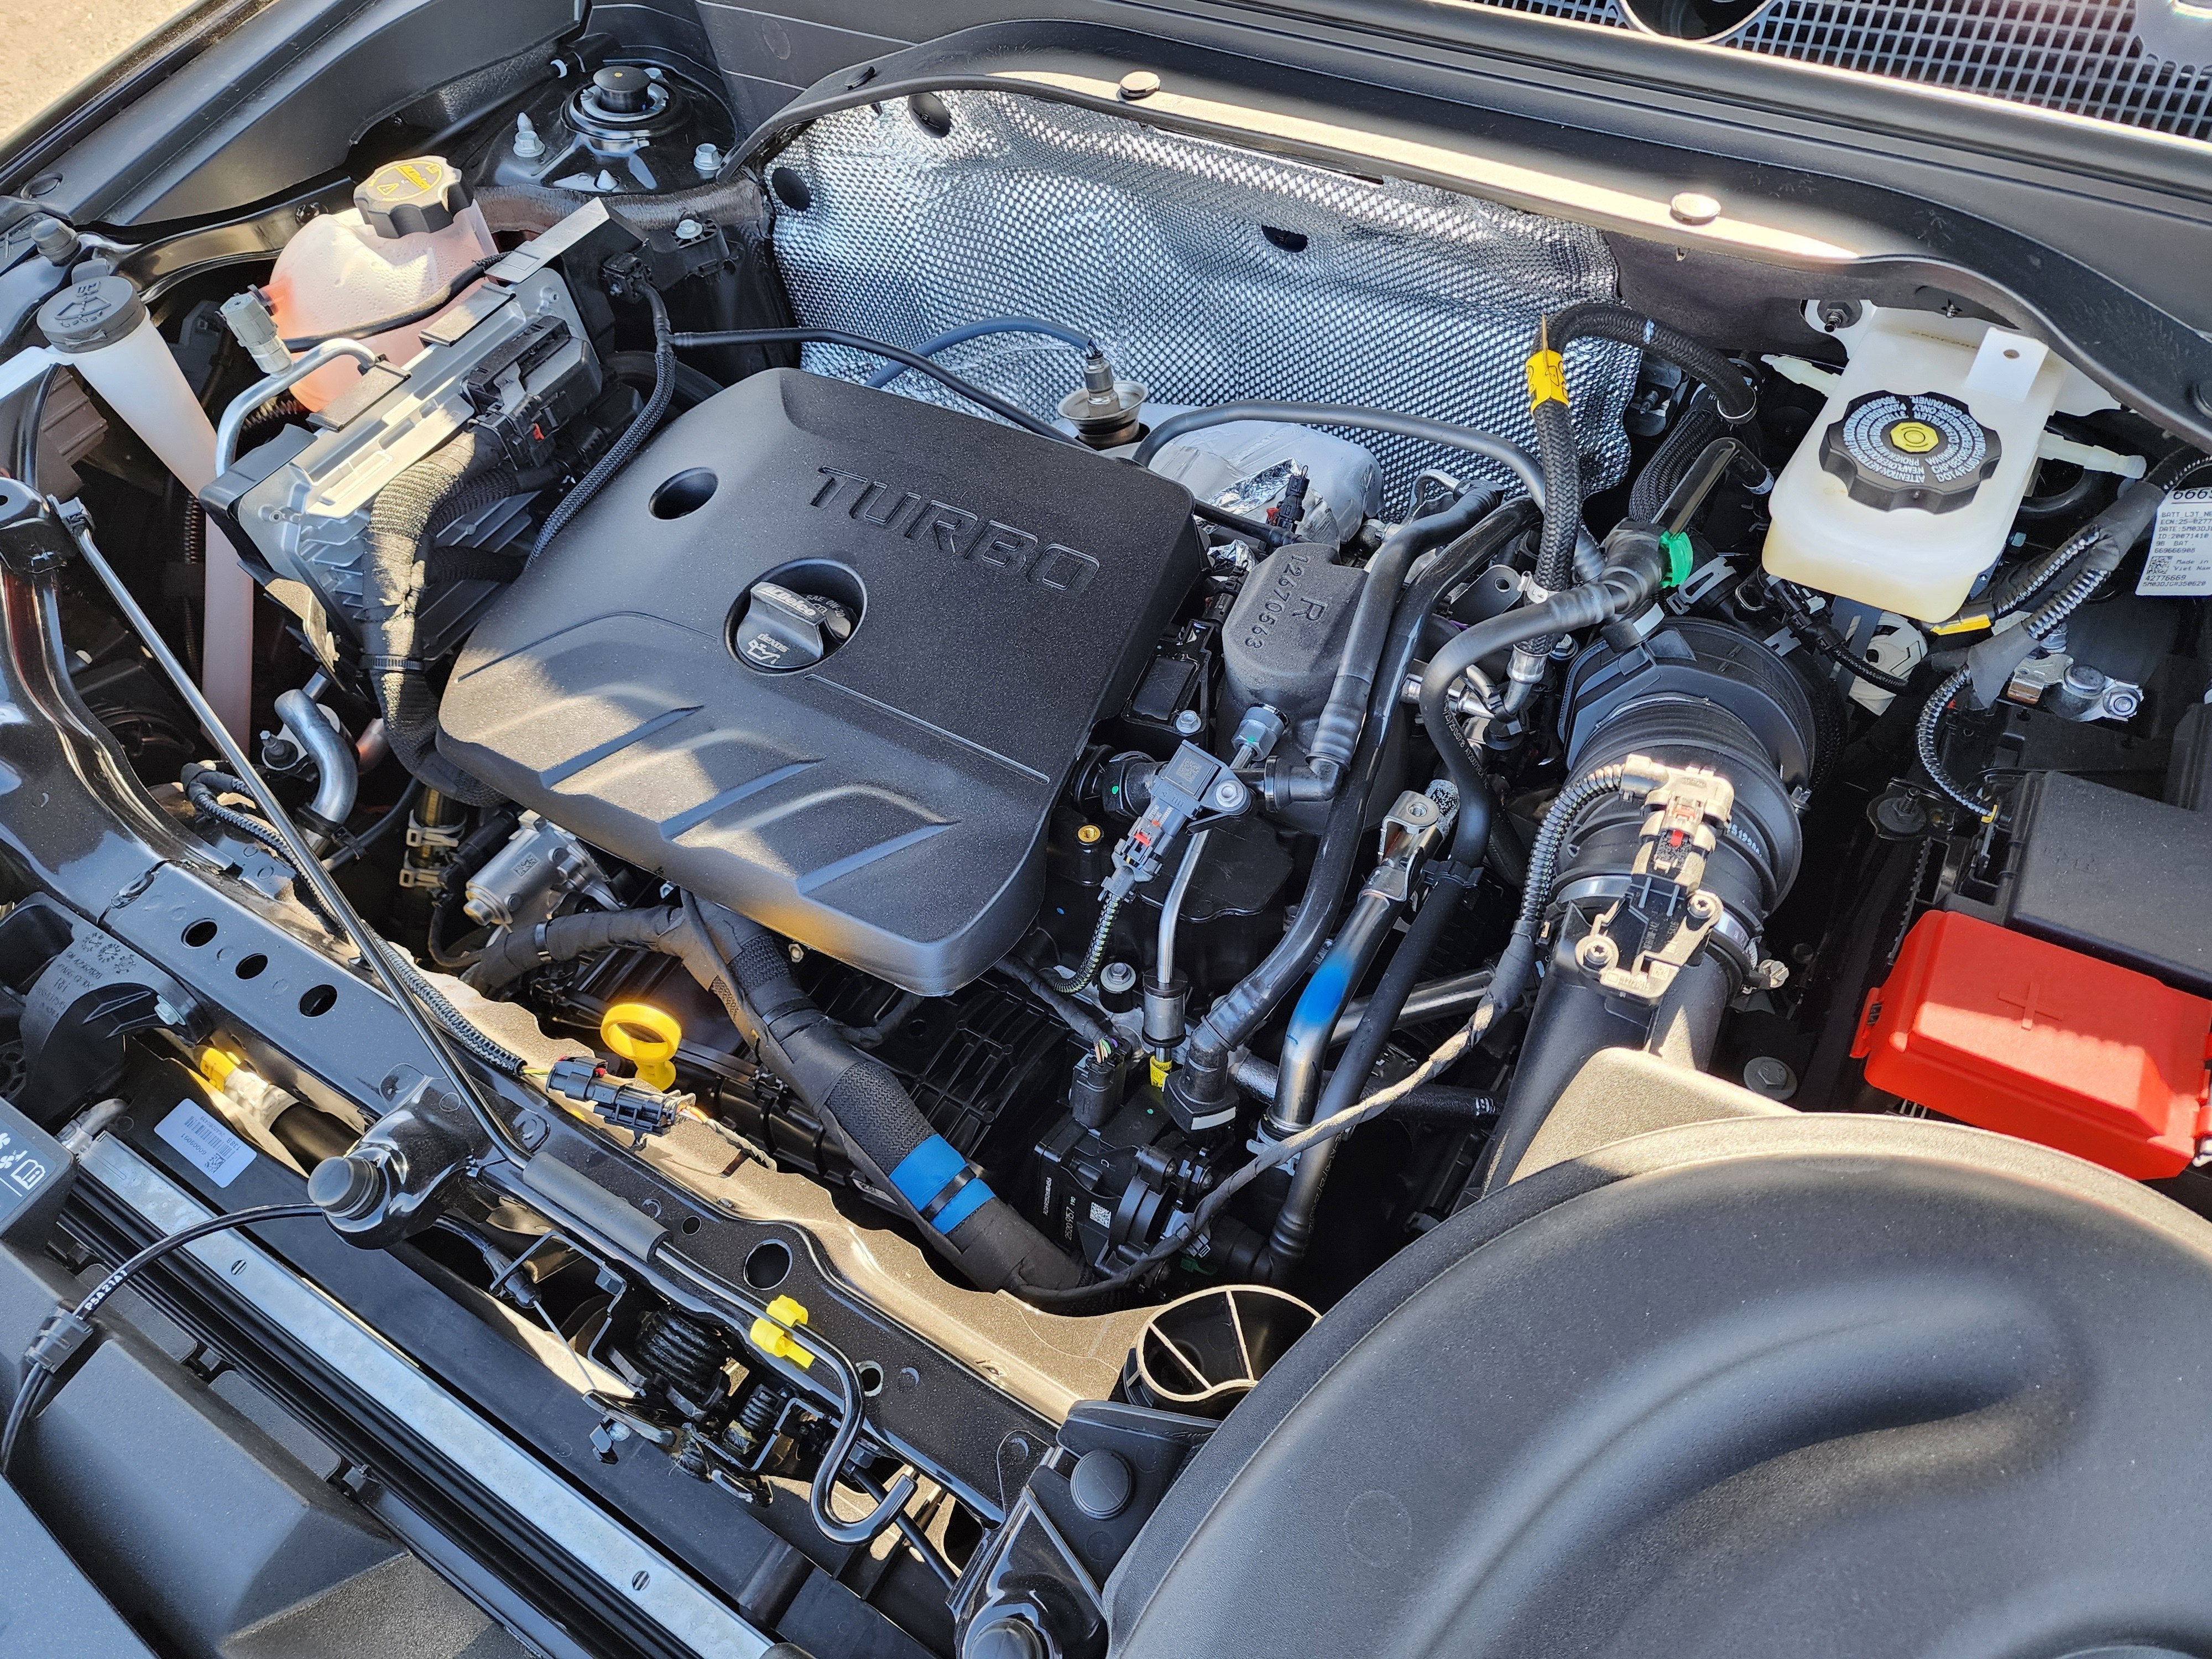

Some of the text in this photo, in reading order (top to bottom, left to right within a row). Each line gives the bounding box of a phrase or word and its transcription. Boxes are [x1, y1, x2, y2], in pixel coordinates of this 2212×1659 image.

[2173, 488, 2212, 500] 666
[811, 466, 1100, 598] TURBO
[760, 586, 816, 617] ACDelco
[805, 594, 846, 618] SAE 0W-20
[1245, 555, 1309, 648] 12670563
[1292, 597, 1328, 621] R
[757, 633, 790, 653] dexos
